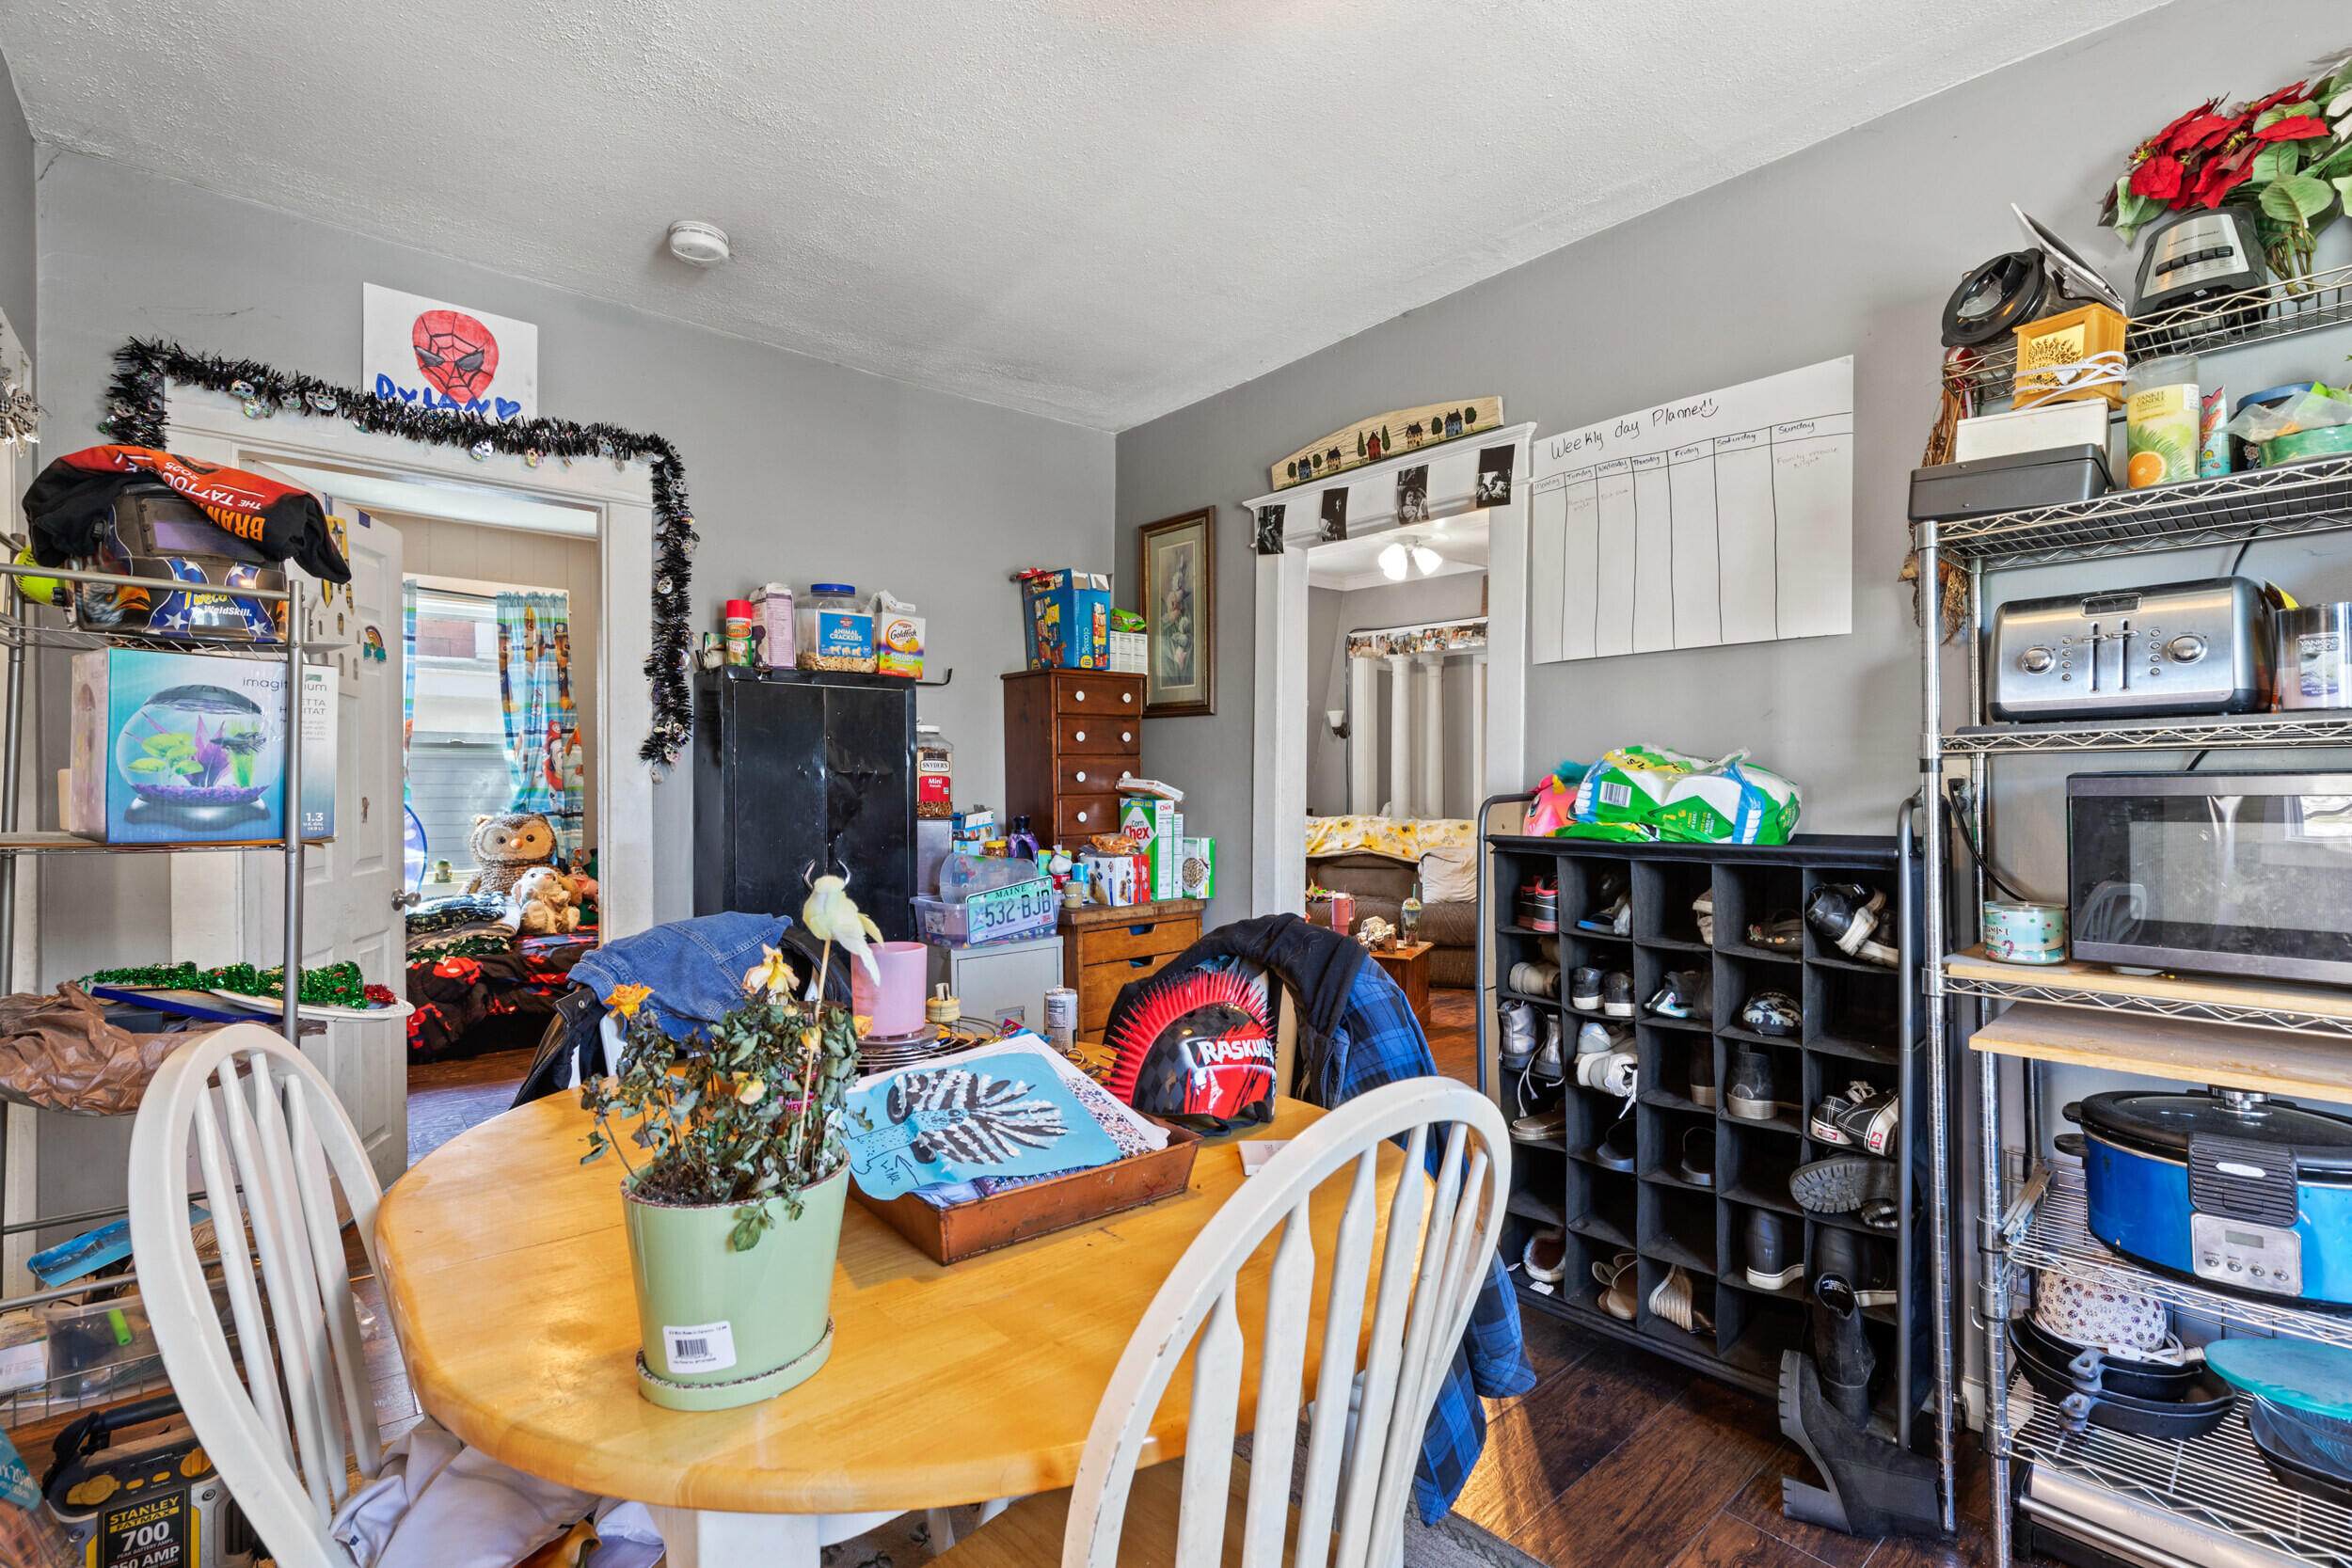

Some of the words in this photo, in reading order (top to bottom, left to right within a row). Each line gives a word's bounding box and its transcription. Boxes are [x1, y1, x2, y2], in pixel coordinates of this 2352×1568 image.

[376, 372, 491, 414] DYLAN
[1551, 431, 1603, 460] Weekly
[1614, 420, 1641, 439] day
[1675, 446, 1700, 457] Friday
[1778, 421, 1815, 435] Sunday
[237, 499, 262, 510] THE
[199, 503, 266, 543] BRAN
[829, 633, 863, 641] CRACKERS
[890, 628, 917, 641] Goldfish
[306, 812, 324, 822] 1.3
[1123, 825, 1150, 840] Chex
[995, 885, 1026, 899] MAINE
[109, 1496, 180, 1525] STANLEY
[117, 1510, 171, 1529] FATMAX
[120, 1521, 169, 1552] 700
[133, 1543, 157, 1555] BATTERY
[157, 1538, 174, 1547] AMPS
[142, 1545, 181, 1567] AMP
